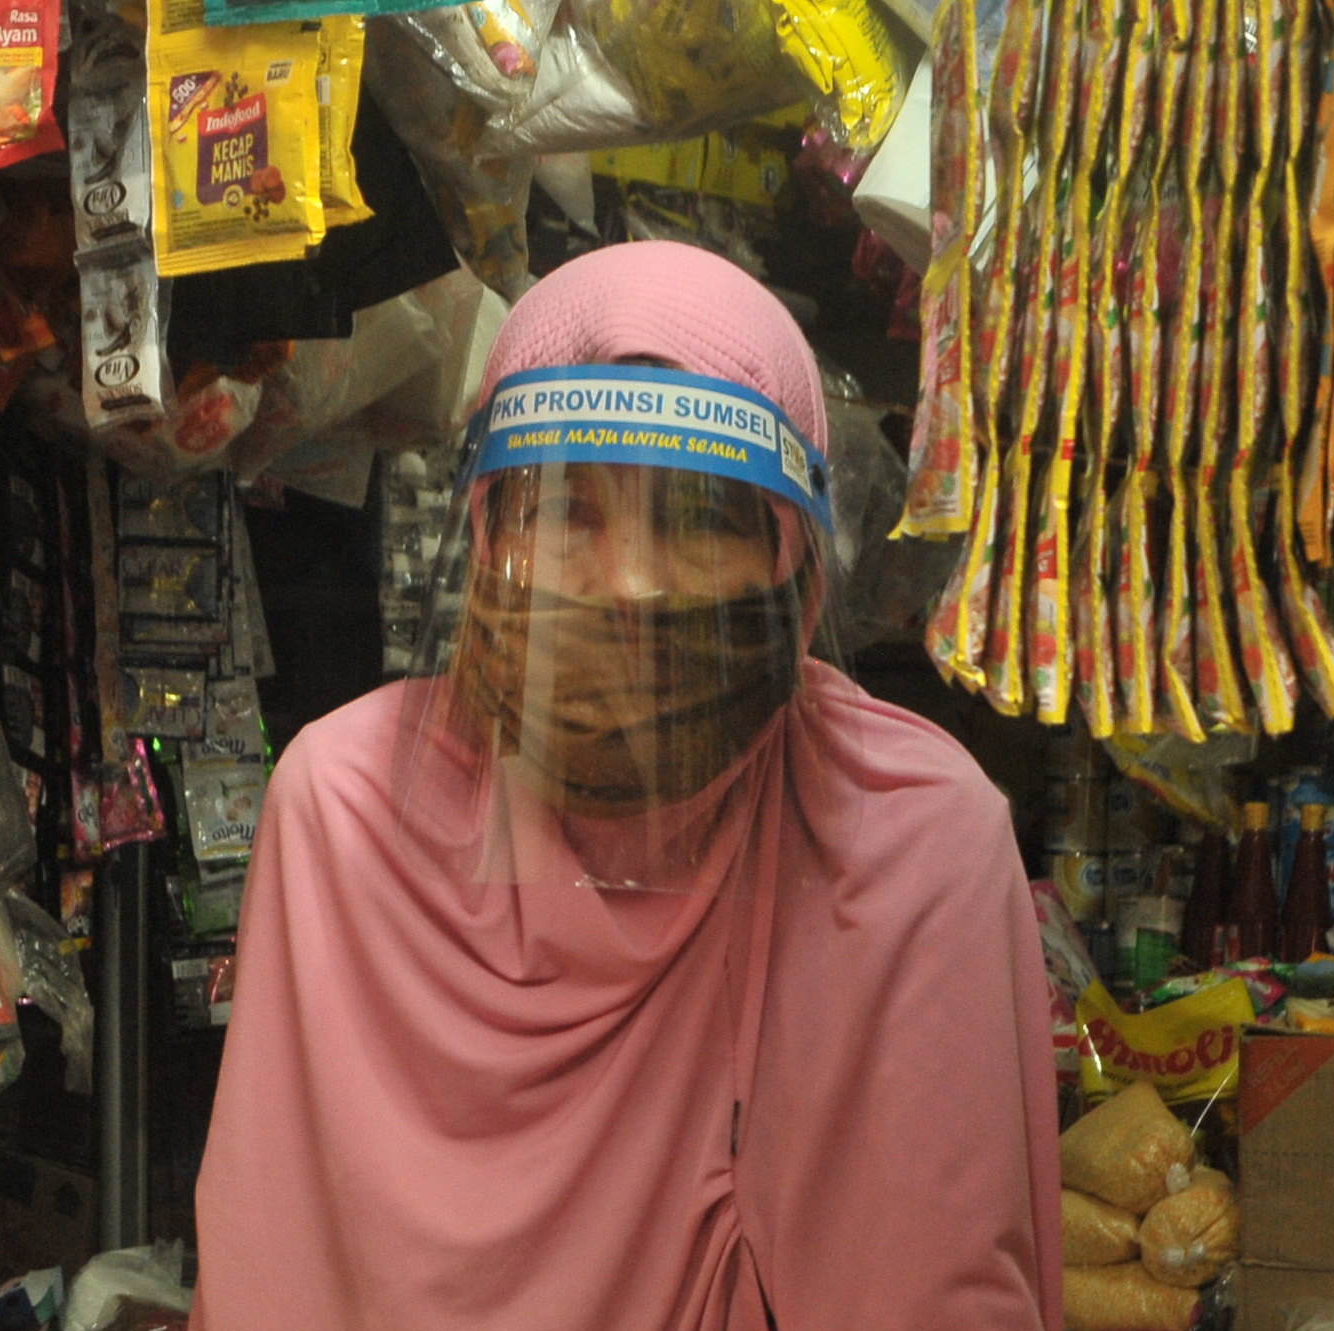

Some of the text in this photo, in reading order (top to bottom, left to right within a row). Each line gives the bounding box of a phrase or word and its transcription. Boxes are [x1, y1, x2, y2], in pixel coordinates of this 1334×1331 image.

[10, 10, 38, 23] Rasa
[206, 102, 261, 132] Indofood
[213, 134, 254, 163] KECAP
[211, 156, 255, 184] MANIS
[493, 389, 774, 442] PKK PROVINSI SUMSEL
